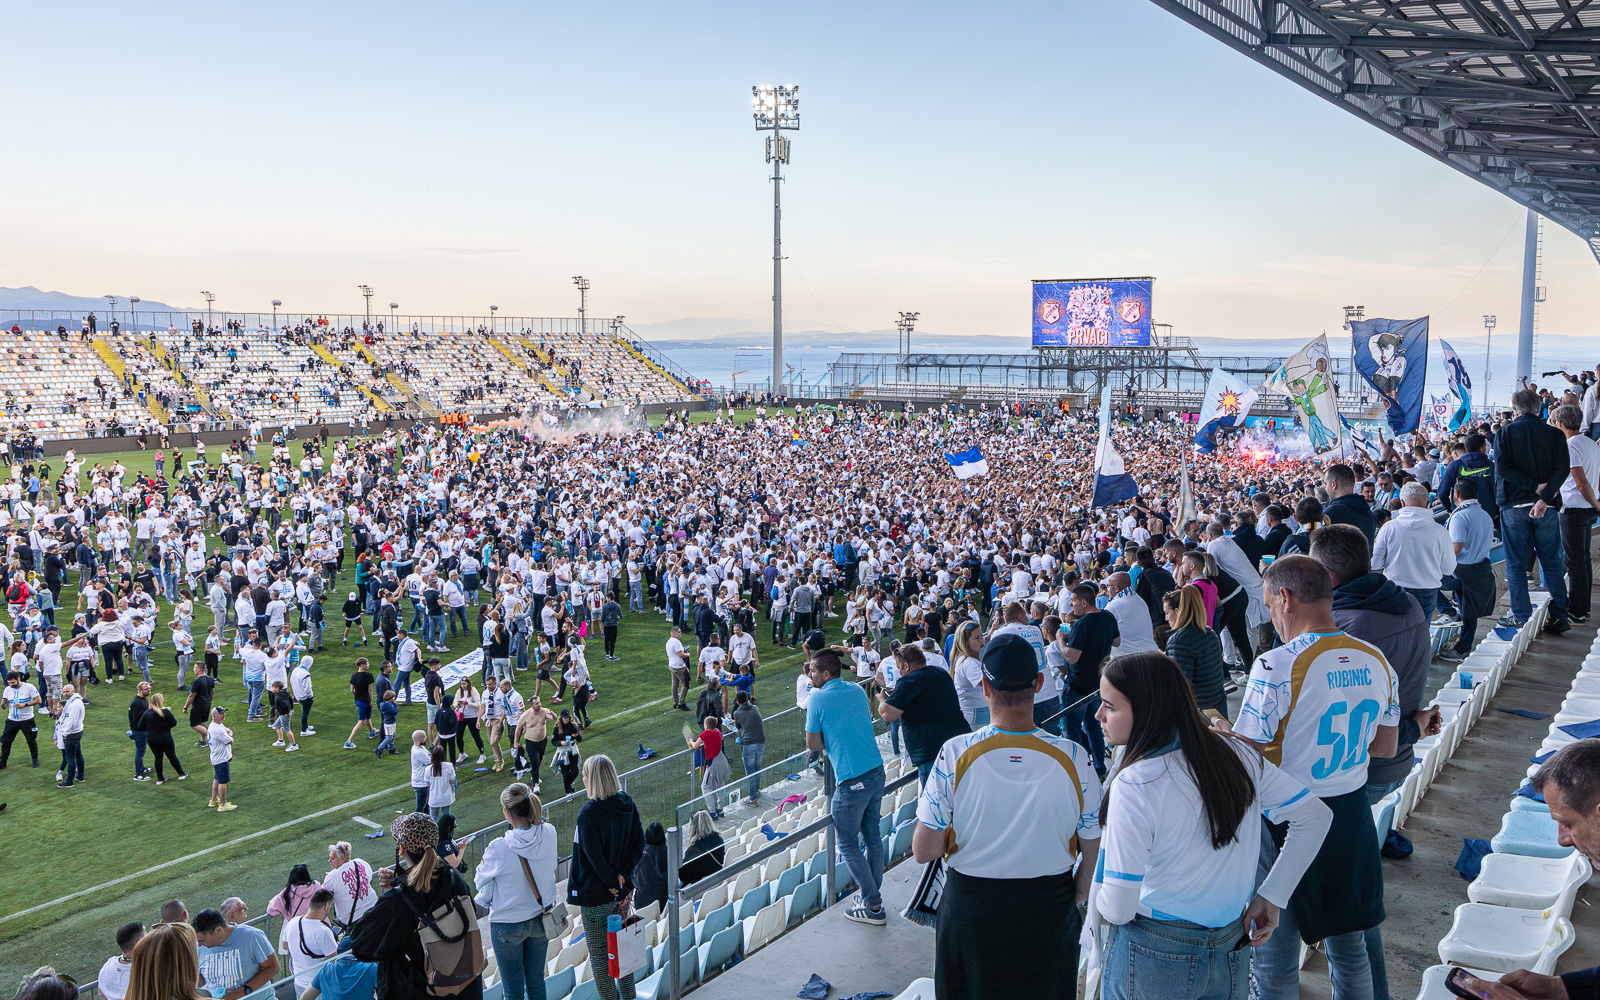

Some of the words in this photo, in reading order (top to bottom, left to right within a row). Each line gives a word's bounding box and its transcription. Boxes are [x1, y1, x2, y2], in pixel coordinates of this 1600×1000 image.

[1068, 328, 1109, 345] PRVACI
[408, 580, 417, 590] 16
[1327, 664, 1373, 690] RUBINIĆ
[1311, 699, 1380, 780] 50
